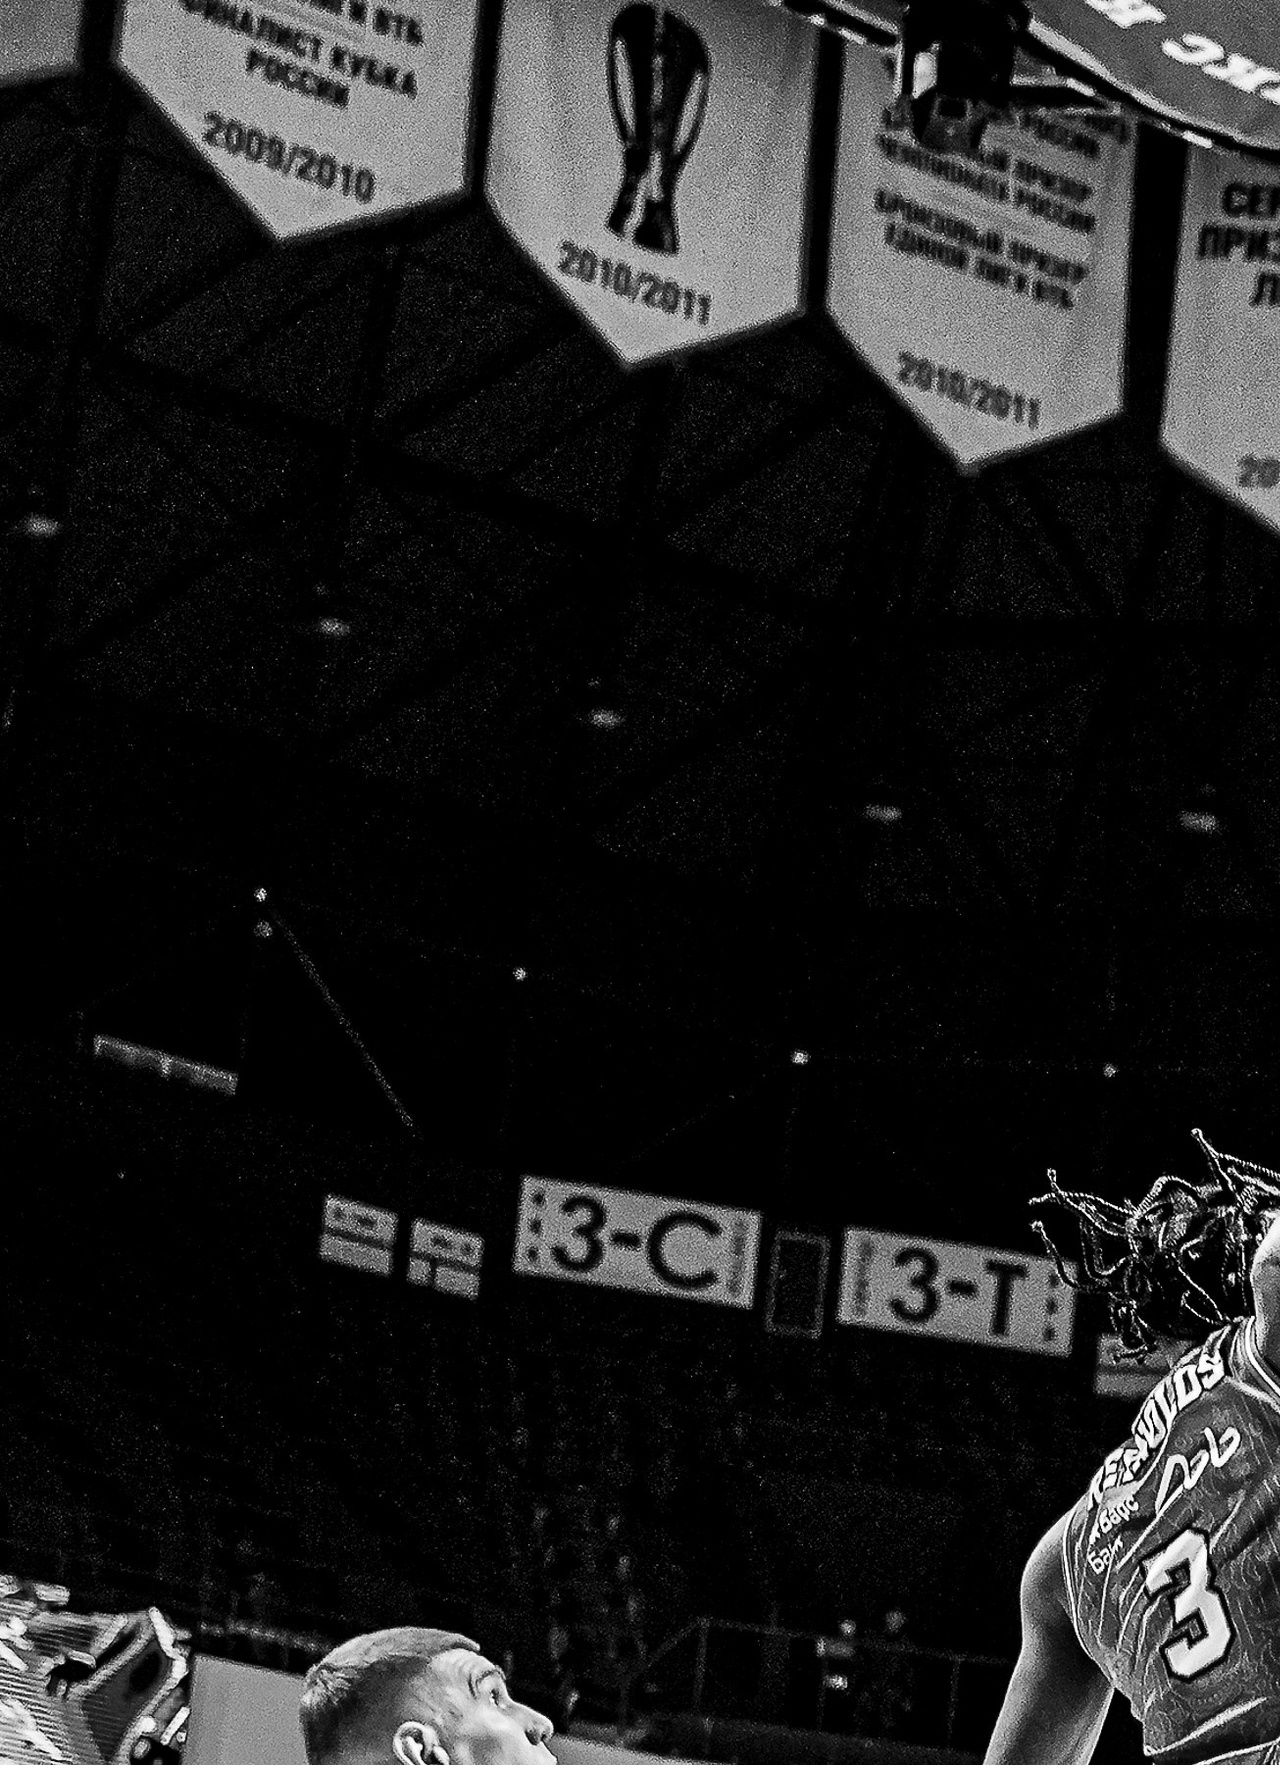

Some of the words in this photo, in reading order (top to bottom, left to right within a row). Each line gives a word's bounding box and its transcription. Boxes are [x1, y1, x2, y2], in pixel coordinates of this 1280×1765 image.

[245, 49, 352, 110] РОССИИ
[202, 110, 376, 204] 2009/2010
[557, 238, 714, 326] 2010/2011
[898, 350, 1042, 429] 2010/2011
[1142, 1527, 1235, 1680] 3
